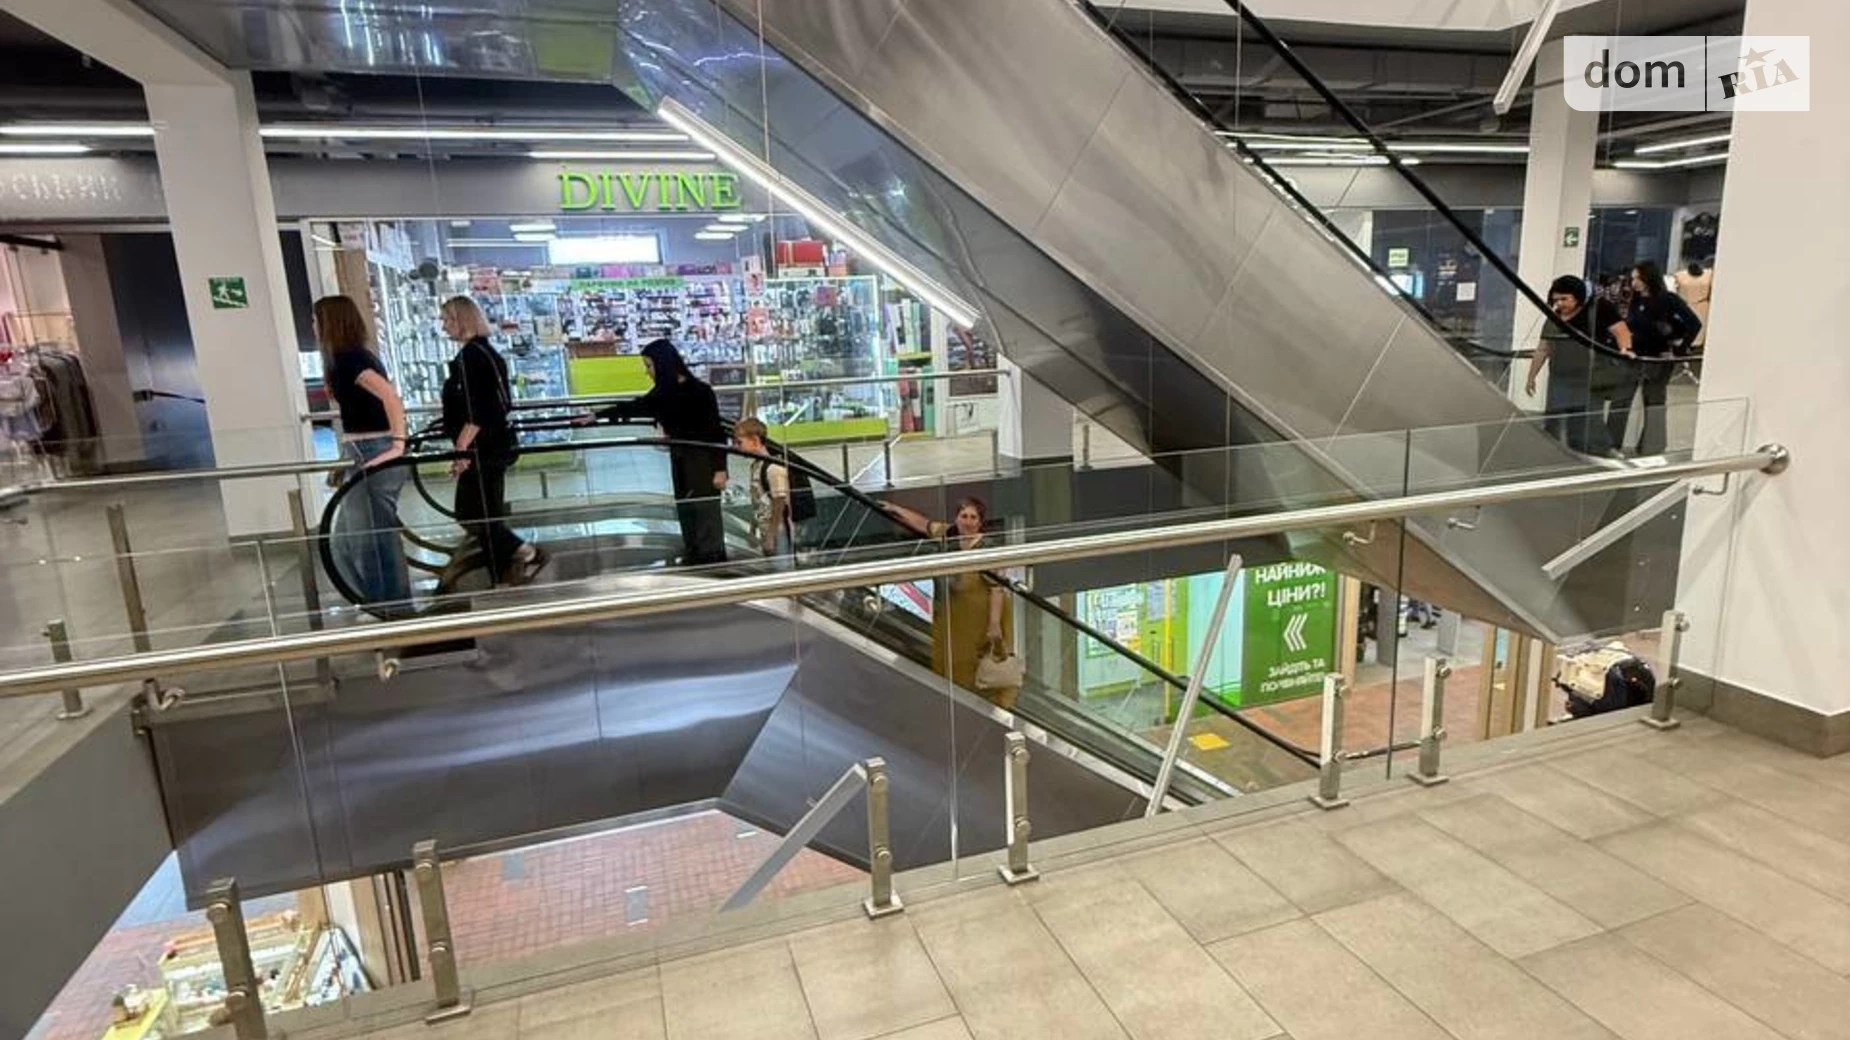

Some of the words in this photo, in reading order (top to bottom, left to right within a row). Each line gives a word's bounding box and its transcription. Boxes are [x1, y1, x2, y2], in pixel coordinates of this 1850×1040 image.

[558, 172, 742, 211] DIVINE
[1267, 582, 1326, 607] ЦІНИ?!
[1312, 658, 1325, 669] ТА
